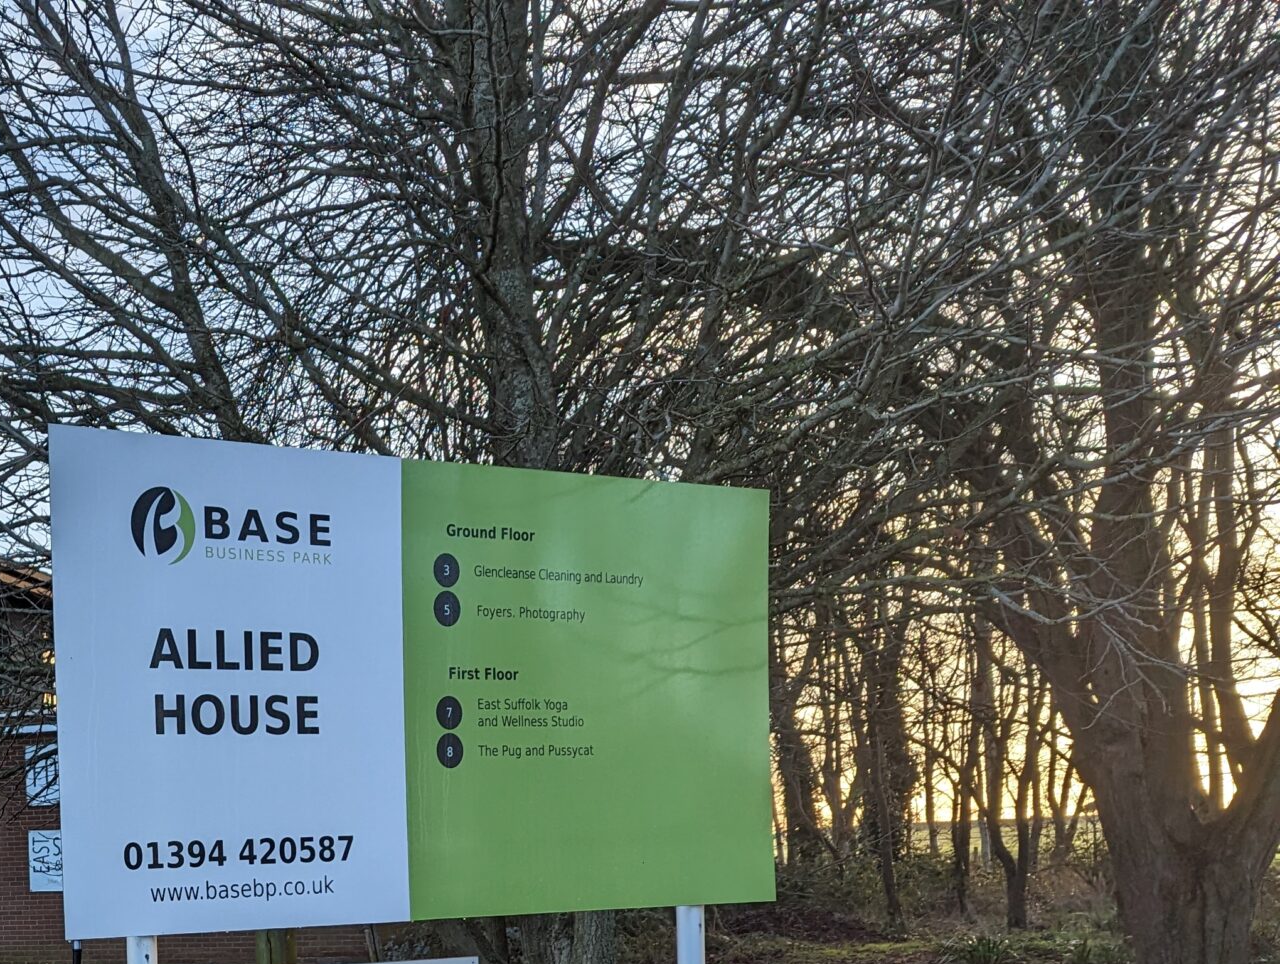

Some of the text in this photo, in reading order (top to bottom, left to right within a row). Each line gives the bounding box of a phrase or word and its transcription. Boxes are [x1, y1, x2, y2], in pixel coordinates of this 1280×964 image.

[204, 505, 332, 547] BASE
[446, 523, 536, 542] Ground Floor
[205, 546, 332, 566] BUSINESS PARK
[443, 564, 644, 587] 3 Glencleanse Cleaning and Laundry
[444, 604, 450, 616] 5
[519, 607, 586, 623] Photography
[149, 628, 320, 672] ALLIED
[448, 667, 519, 681] First Floor
[155, 694, 321, 735] HOUSE
[446, 707, 453, 719] 7
[477, 697, 568, 713] East Suffolk Yoga
[477, 715, 585, 728] and Wellness Studio
[447, 743, 594, 759] 8 The Pug and Pussycat
[32, 836, 50, 872] EAST
[124, 835, 354, 870] 01394 420587
[151, 875, 335, 902] www.basebp.co.uk
